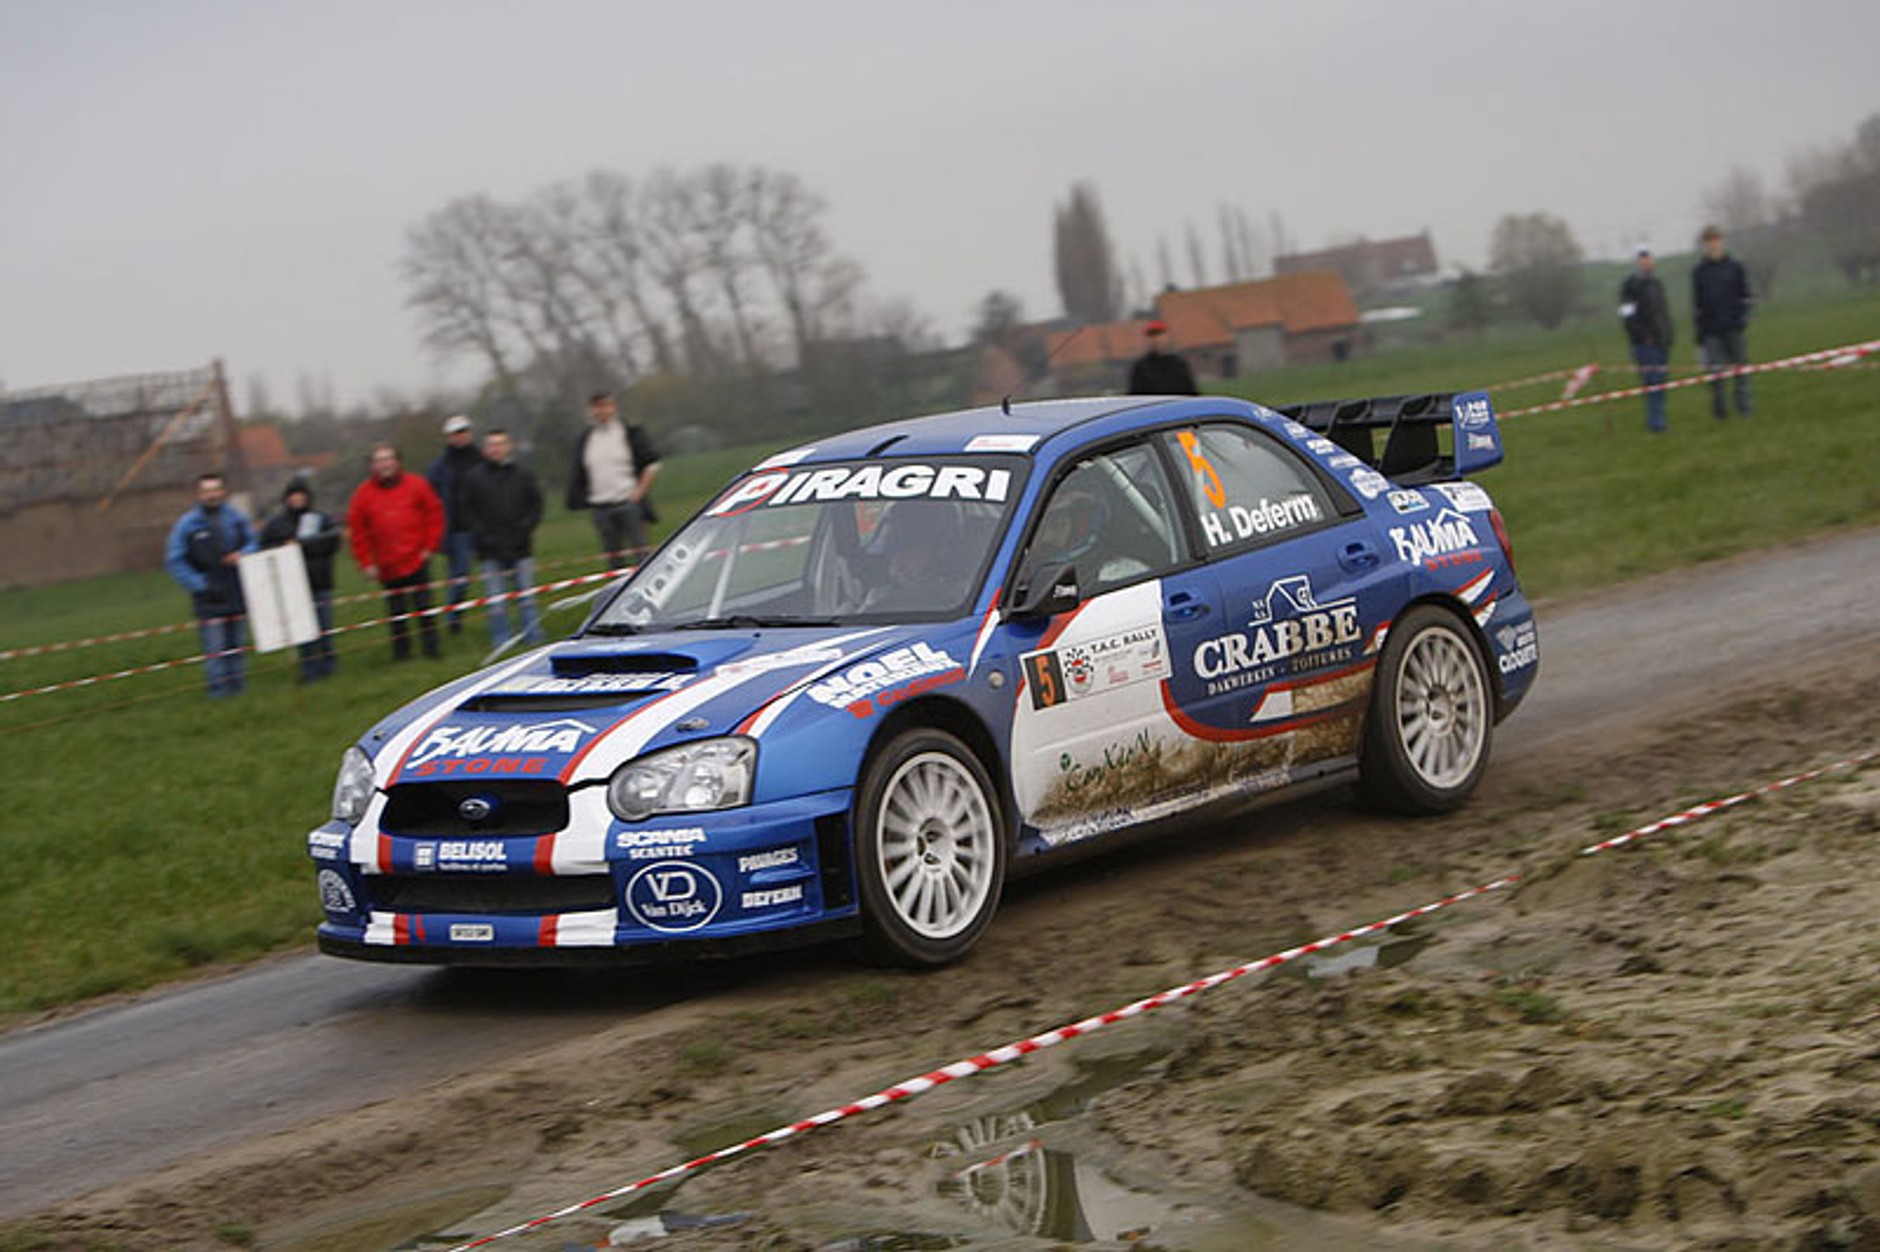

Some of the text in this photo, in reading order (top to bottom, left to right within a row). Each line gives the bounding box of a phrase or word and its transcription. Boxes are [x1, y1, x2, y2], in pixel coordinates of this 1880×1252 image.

[704, 465, 1011, 517] PIRAGRI
[1176, 431, 1227, 509] 5
[1201, 494, 1318, 547] H. Deferm
[1090, 629, 1158, 654] T.A.C. RALLY
[1193, 606, 1362, 679] CRABBE
[806, 642, 953, 704] NOEL
[1034, 656, 1056, 707] 5
[413, 758, 549, 776] STONE
[438, 842, 507, 861] BELISOL
[616, 827, 707, 848] SCANIA
